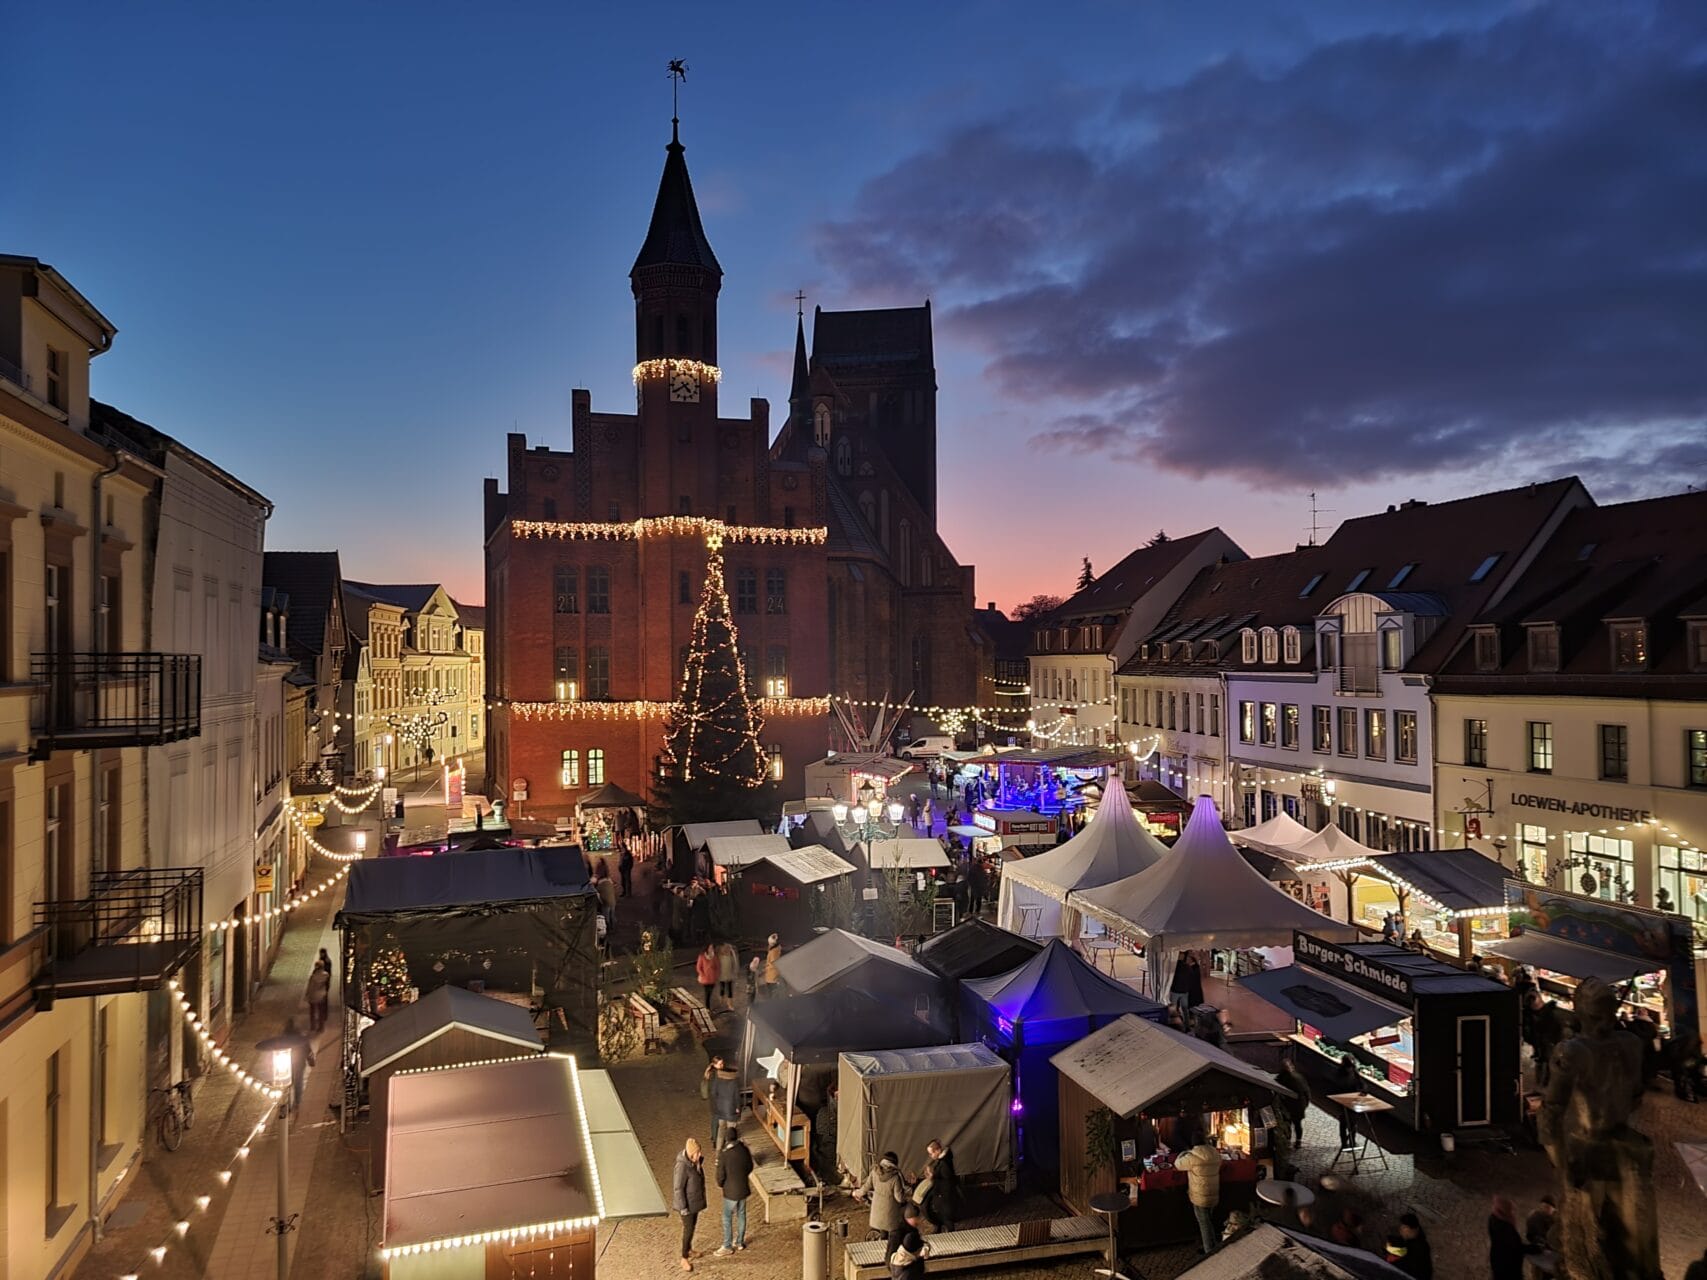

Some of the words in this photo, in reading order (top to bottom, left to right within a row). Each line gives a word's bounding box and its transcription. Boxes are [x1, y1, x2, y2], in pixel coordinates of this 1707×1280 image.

[558, 595, 575, 614] 21
[768, 597, 784, 614] 24
[559, 682, 576, 699] 11
[768, 680, 785, 696] 15
[1511, 793, 1650, 824] LOEWEN-APOTHEKE
[1298, 935, 1407, 992] Burger-Schmiede
